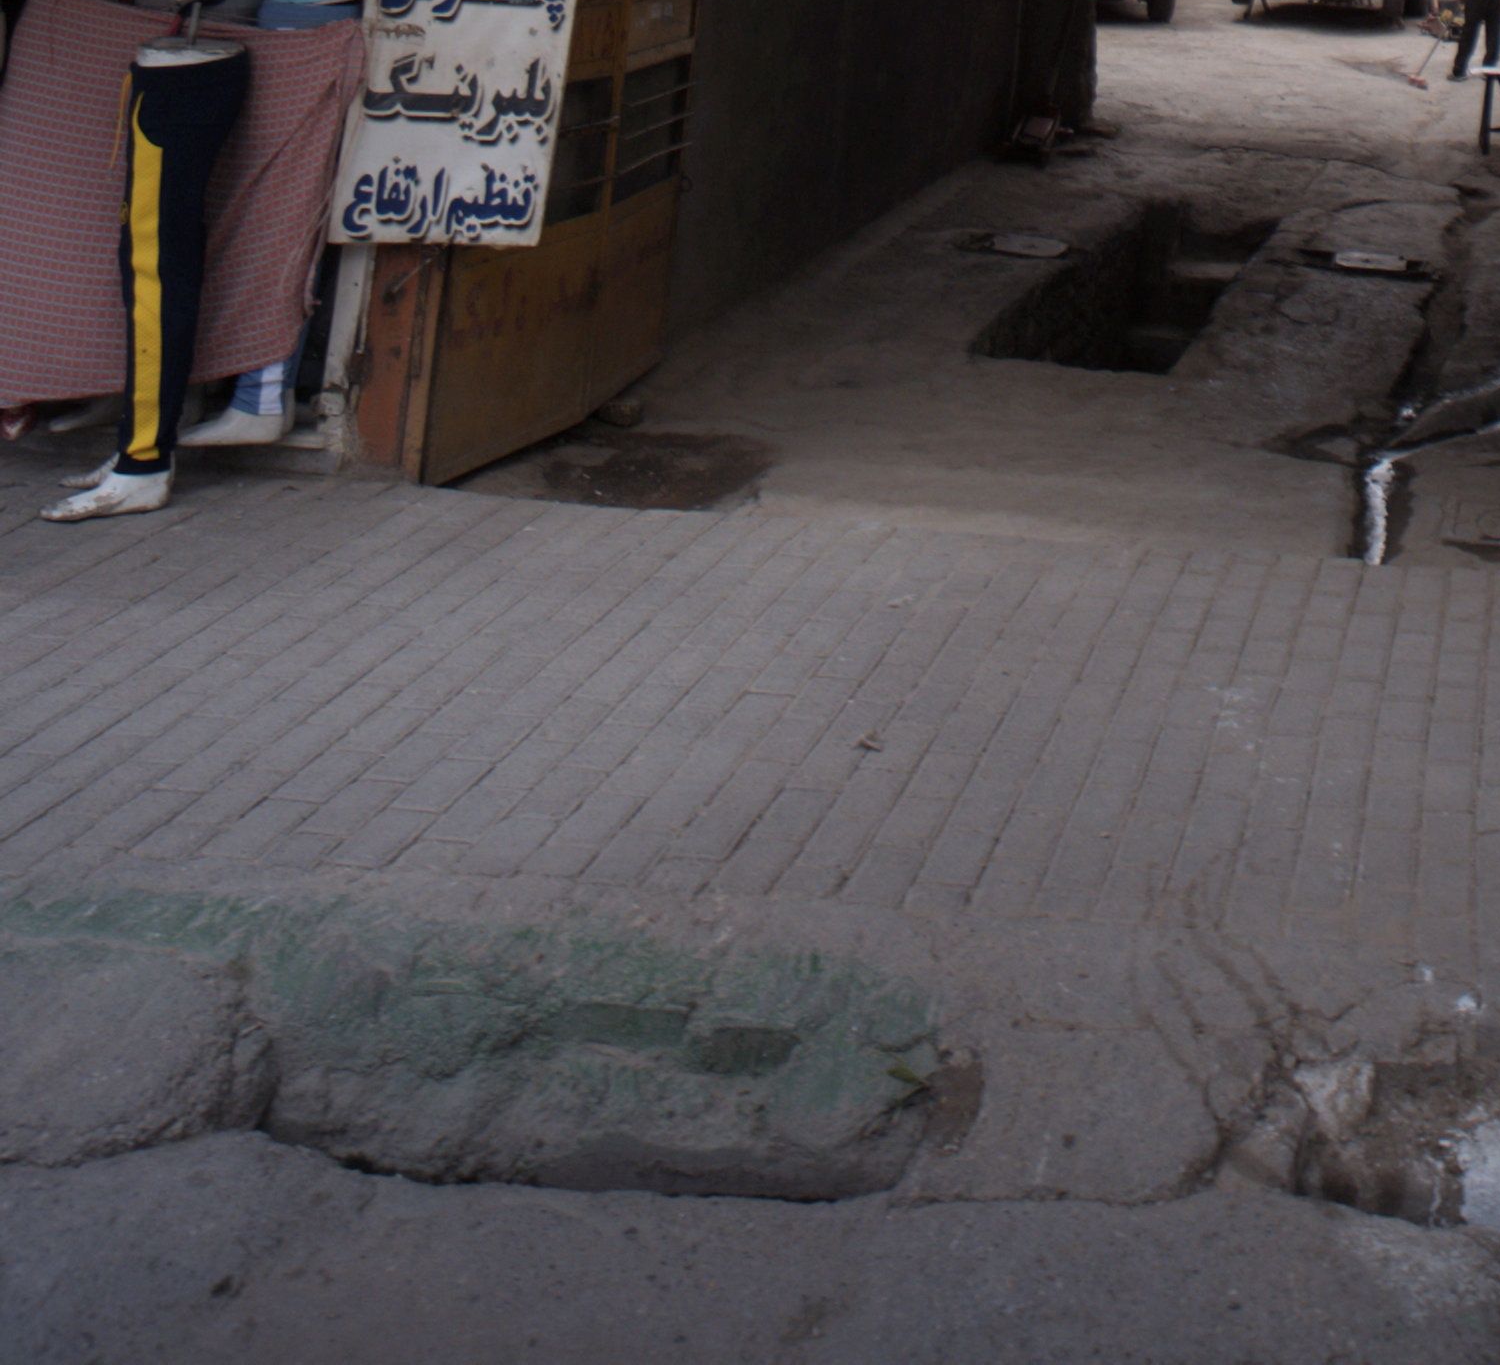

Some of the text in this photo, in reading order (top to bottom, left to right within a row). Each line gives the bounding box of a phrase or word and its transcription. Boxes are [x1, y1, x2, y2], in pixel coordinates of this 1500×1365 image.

[363, 53, 552, 137] بلبرینگ
[343, 165, 537, 235] تنظیم ارتفاع
